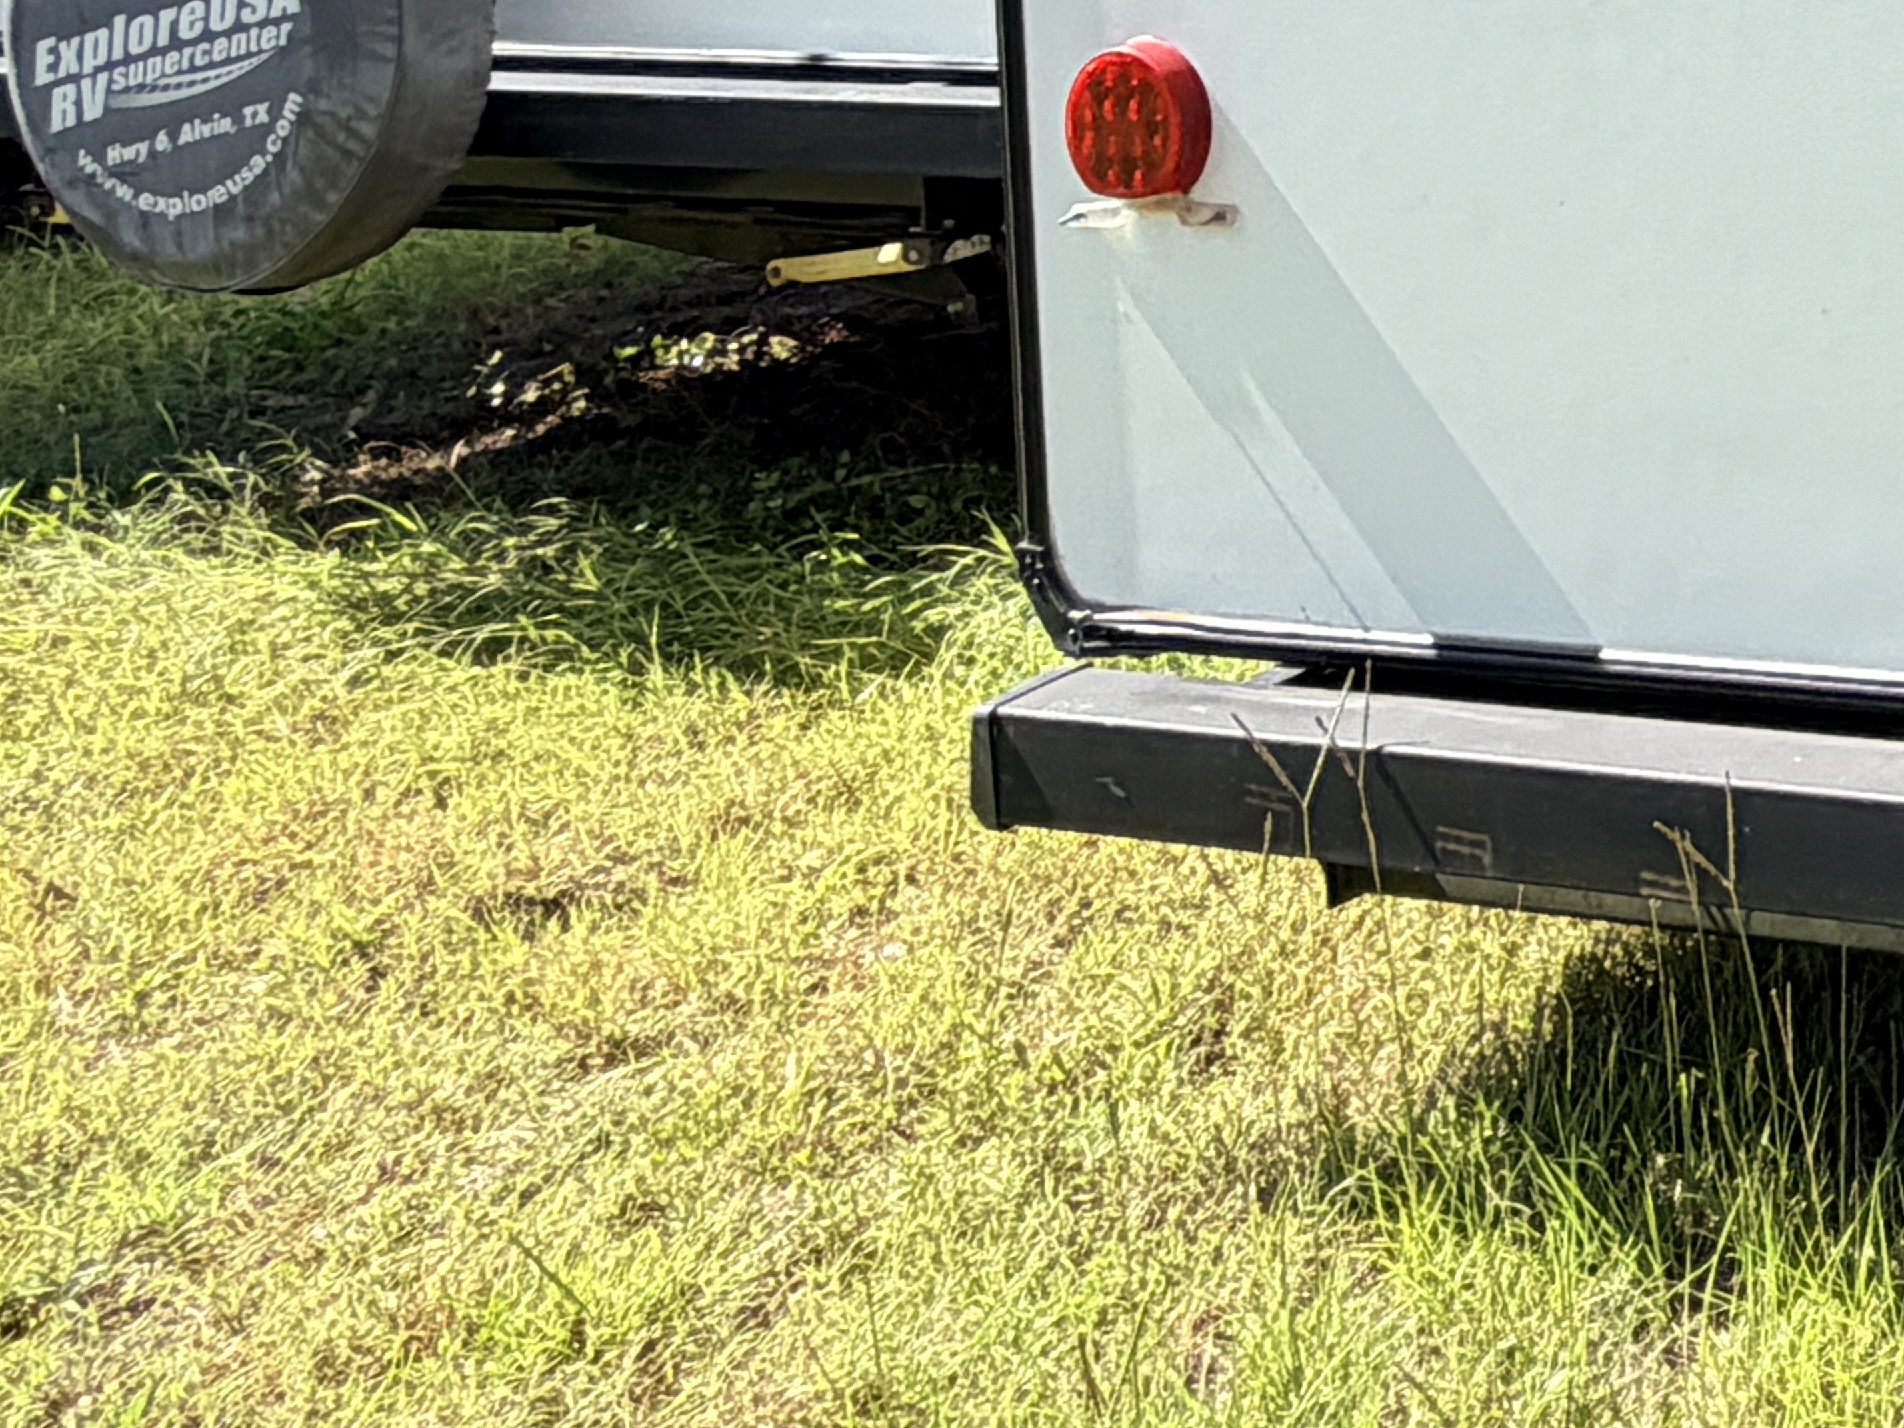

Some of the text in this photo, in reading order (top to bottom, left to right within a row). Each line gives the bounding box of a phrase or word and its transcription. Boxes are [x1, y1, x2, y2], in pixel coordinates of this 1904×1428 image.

[50, 21, 294, 134] RV supercenter
[106, 138, 150, 167] Hwy
[242, 100, 271, 128] TX
